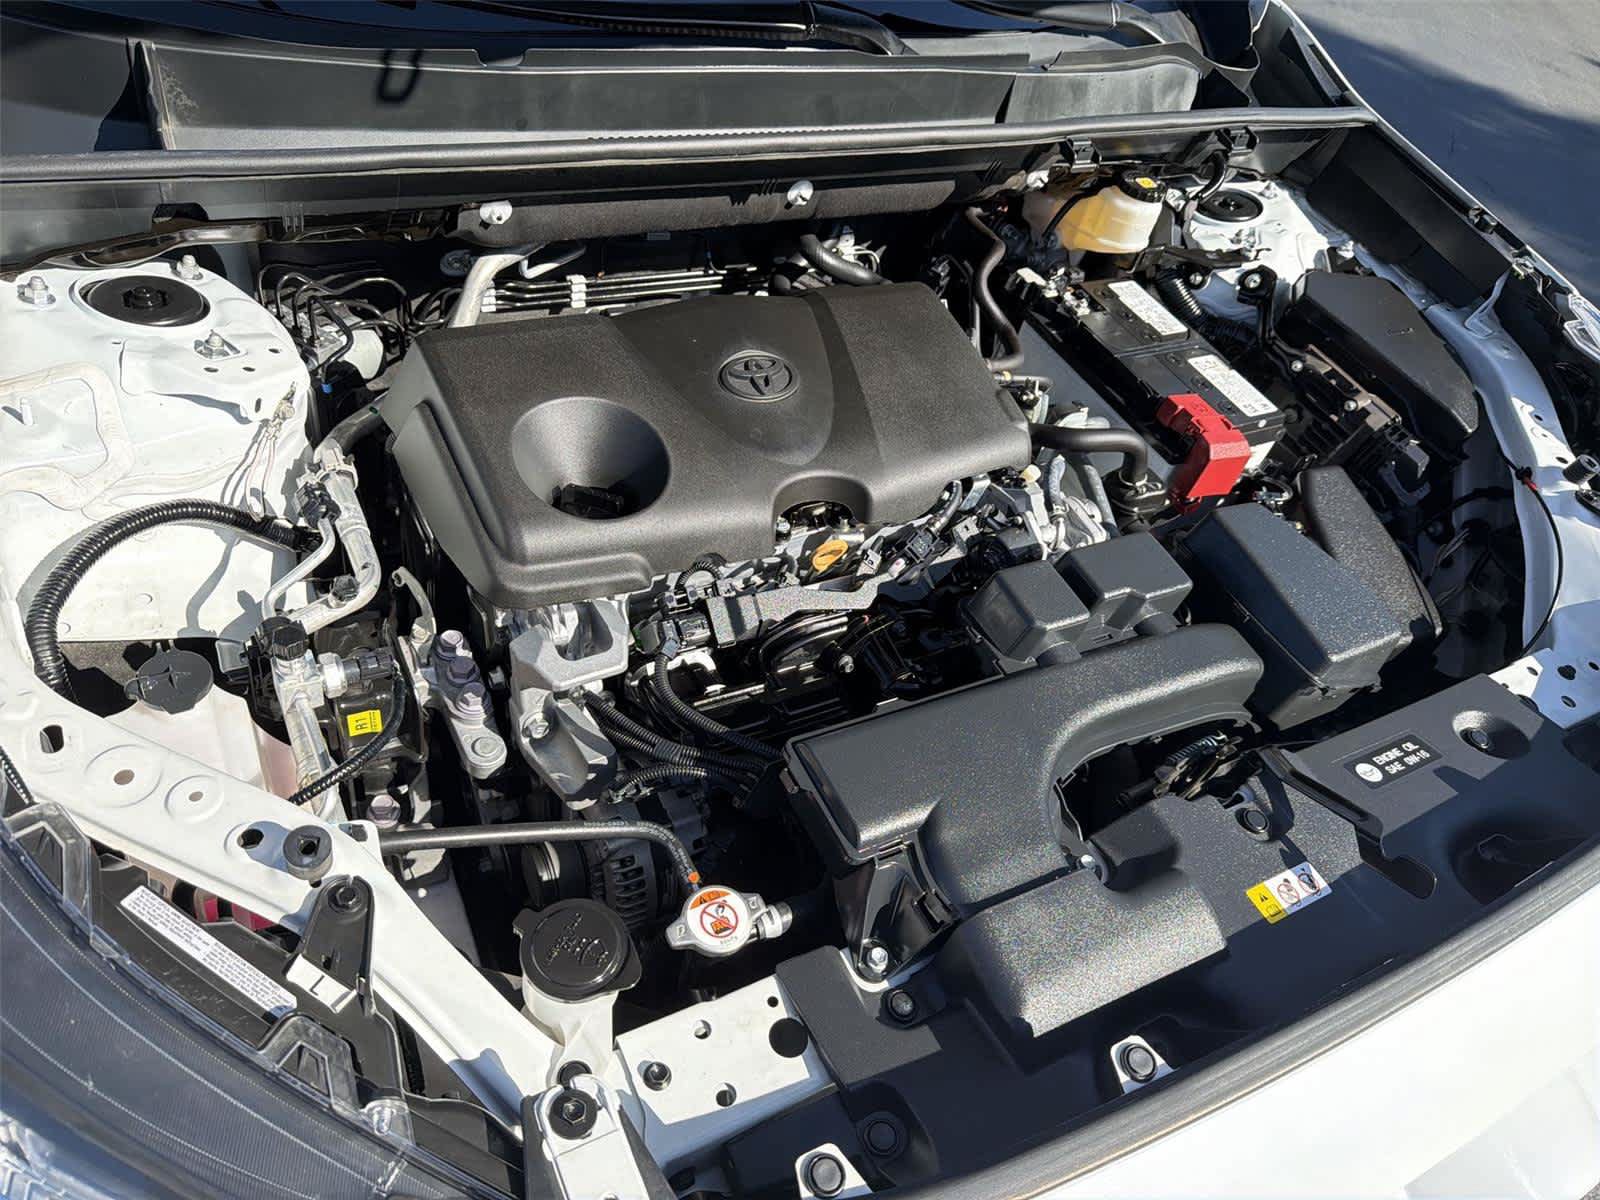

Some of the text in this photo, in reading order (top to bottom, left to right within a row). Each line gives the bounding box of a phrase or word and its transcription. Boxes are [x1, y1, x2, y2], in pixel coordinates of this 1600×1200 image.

[355, 718, 368, 731] R1
[1372, 742, 1419, 765] ENGINE OIL
[1385, 761, 1406, 774] SAE
[309, 974, 325, 996] L
